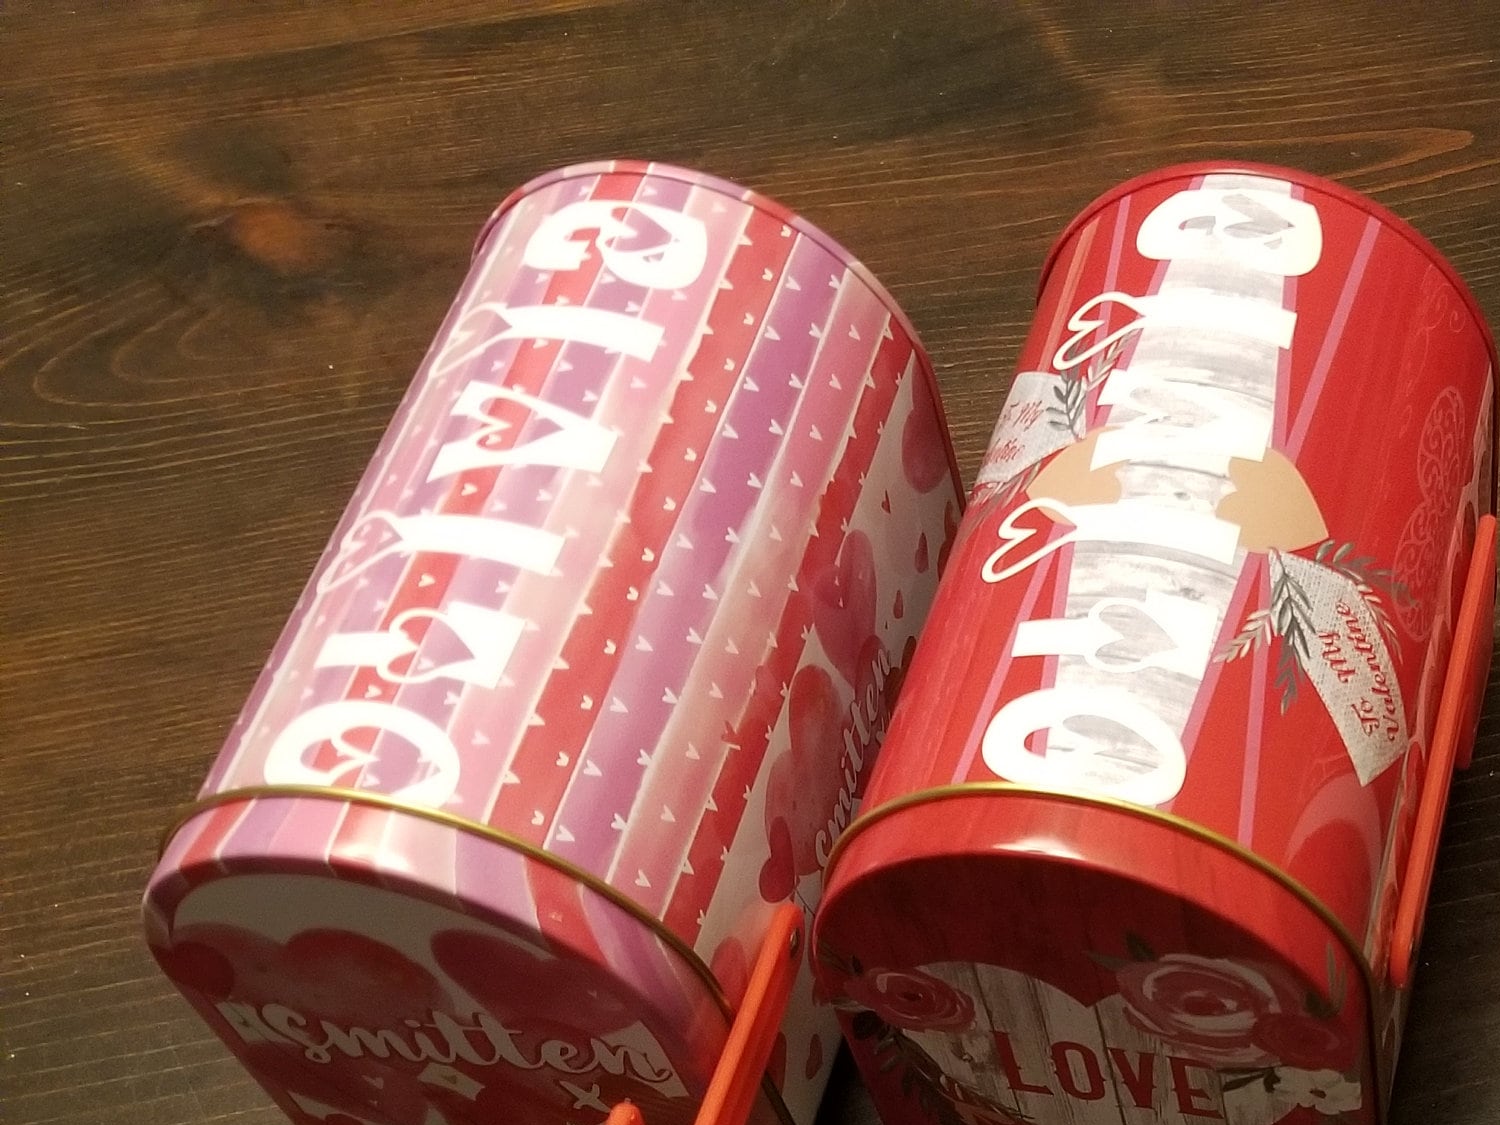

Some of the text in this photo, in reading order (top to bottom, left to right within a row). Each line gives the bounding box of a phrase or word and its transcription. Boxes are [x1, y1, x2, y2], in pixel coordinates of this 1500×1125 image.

[1316, 629, 1380, 737] To My
[1334, 600, 1400, 742] Valentine
[991, 1029, 1225, 1121] LOVE
